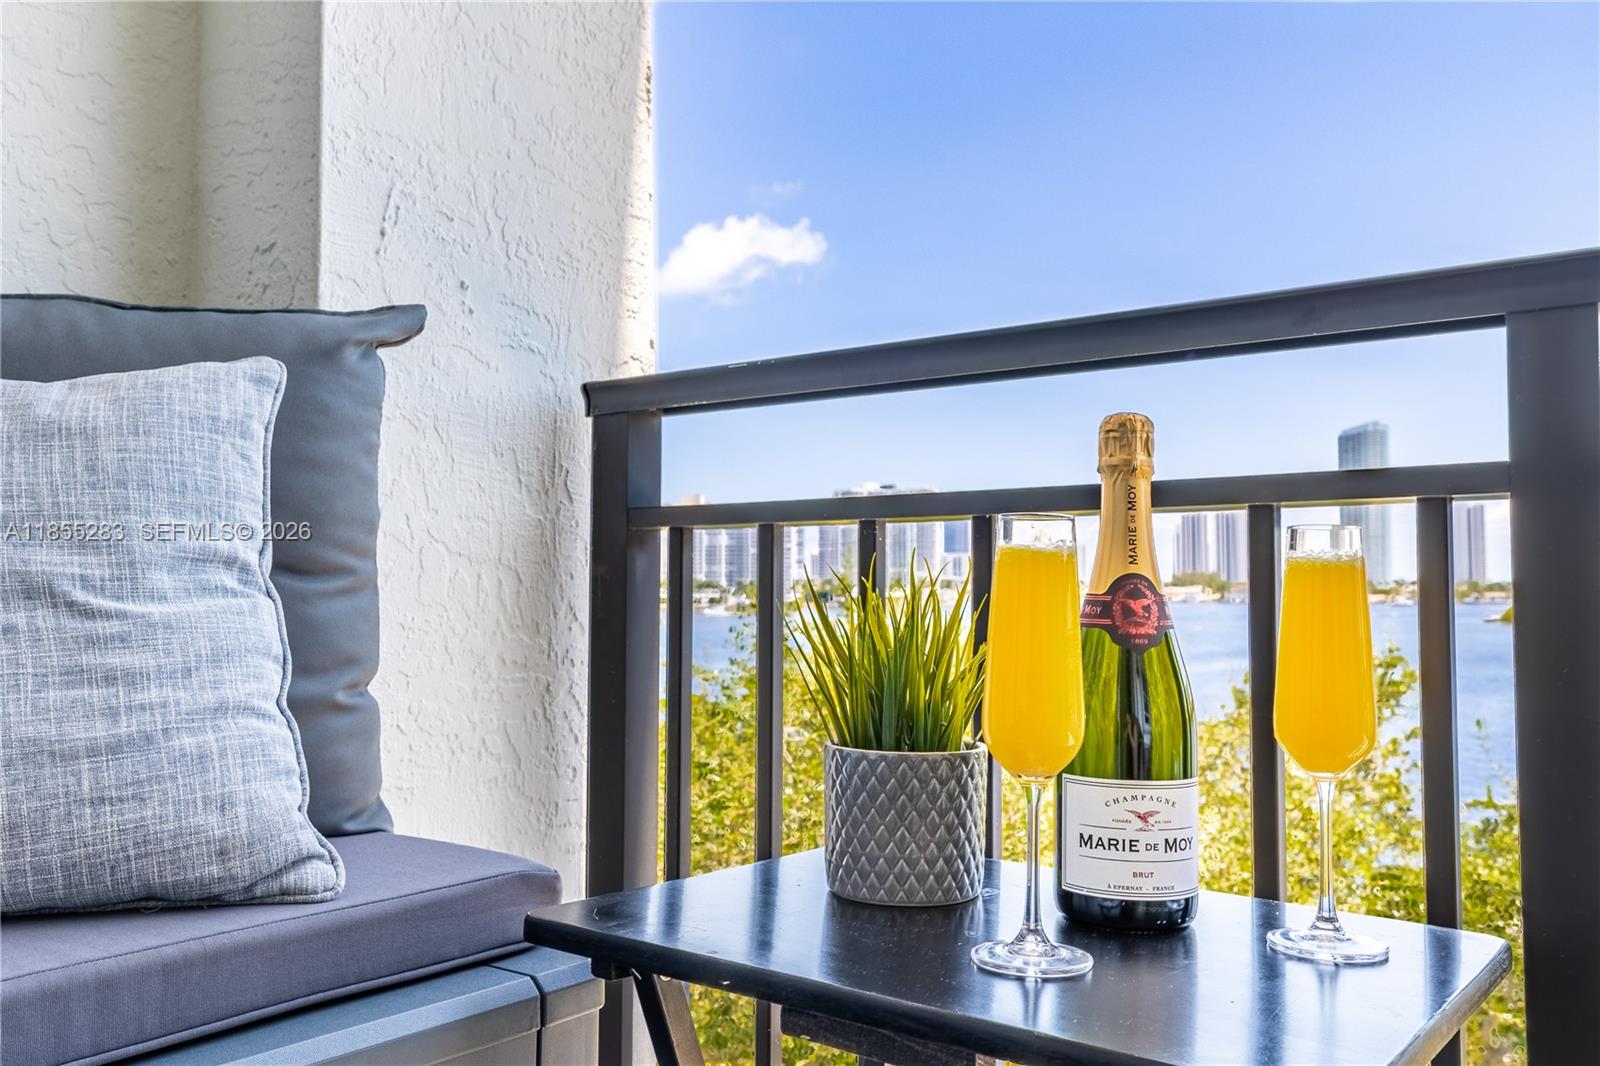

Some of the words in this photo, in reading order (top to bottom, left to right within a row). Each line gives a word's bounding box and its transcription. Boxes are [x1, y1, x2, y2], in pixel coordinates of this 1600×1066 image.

[1127, 484, 1137, 511] MOY
[1130, 514, 1136, 524] DE
[1127, 526, 1139, 565] MARIE
[1084, 604, 1102, 615] MOY
[1104, 794, 1177, 808] CHAMPAGNE
[1079, 832, 1140, 853] MARIE
[1145, 843, 1160, 852] DE
[1164, 836, 1194, 854] MOY
[1132, 871, 1154, 879] BRUT
[1152, 884, 1175, 892] FRANCE
